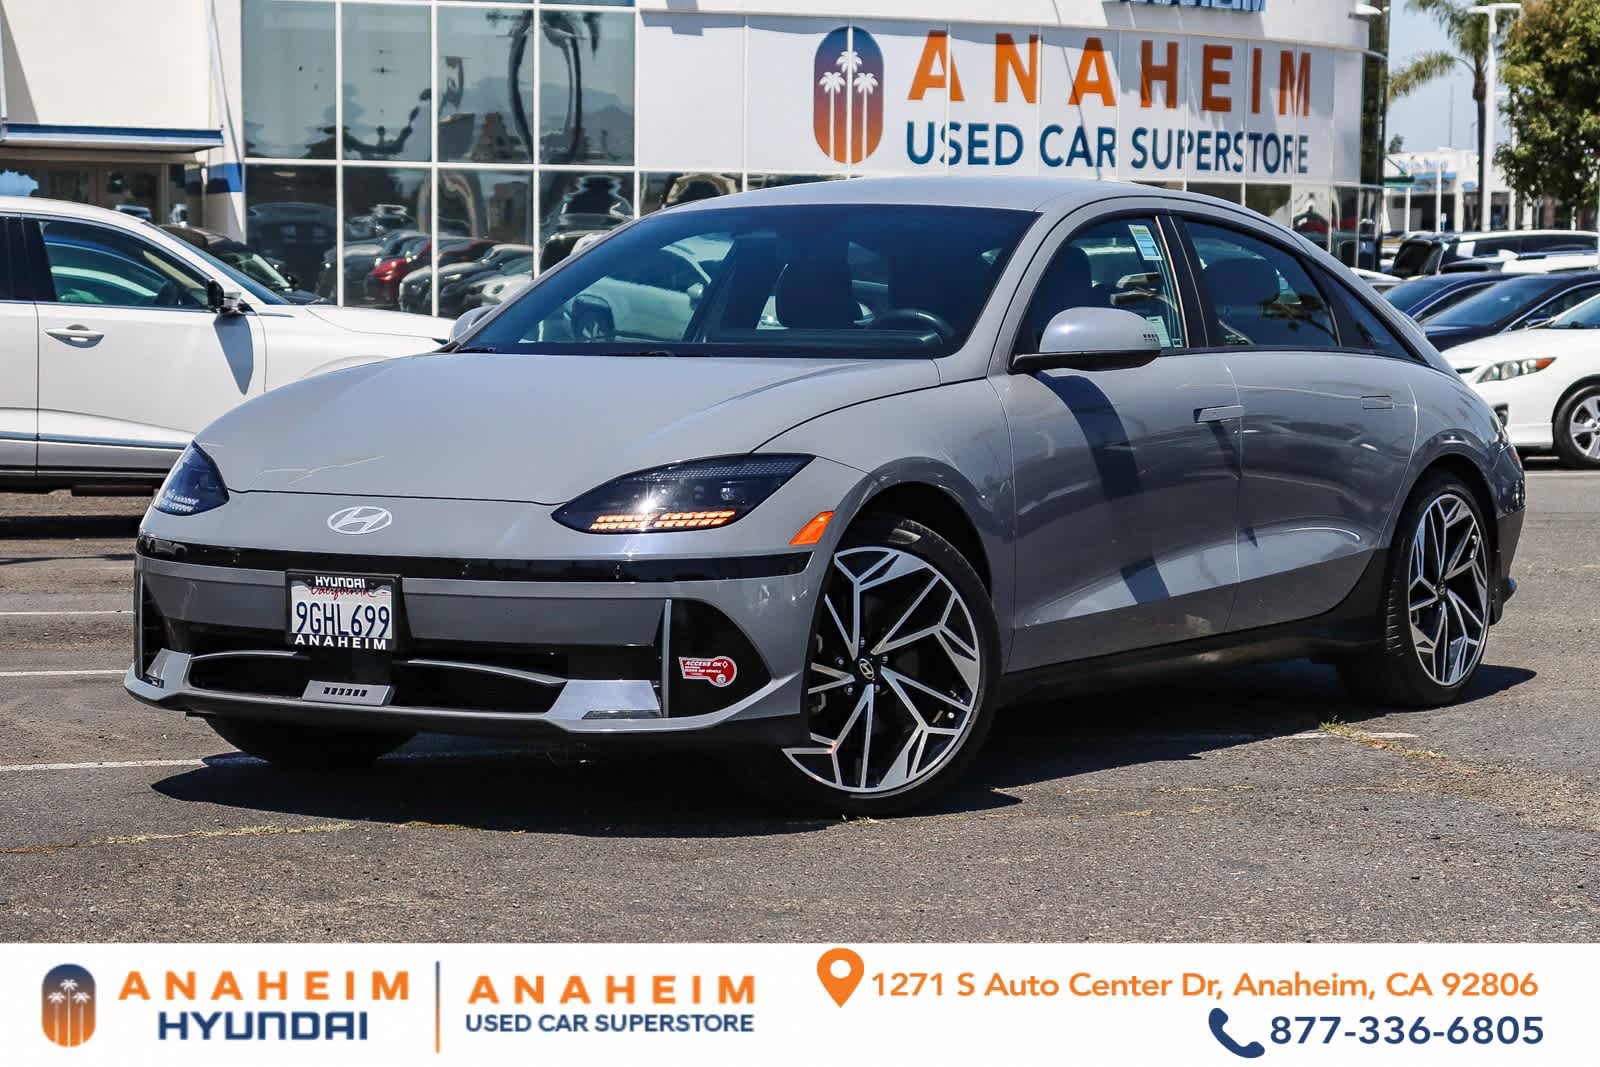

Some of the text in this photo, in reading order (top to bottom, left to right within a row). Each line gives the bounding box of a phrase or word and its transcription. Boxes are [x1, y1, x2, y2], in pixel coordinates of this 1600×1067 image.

[907, 29, 1312, 117] ANAHEIM
[906, 121, 1309, 174] USED CAR SUPERSTORE
[315, 576, 366, 589] HYUNDAI
[296, 601, 390, 638] 9GHL699
[294, 634, 387, 651] ANAHEIM
